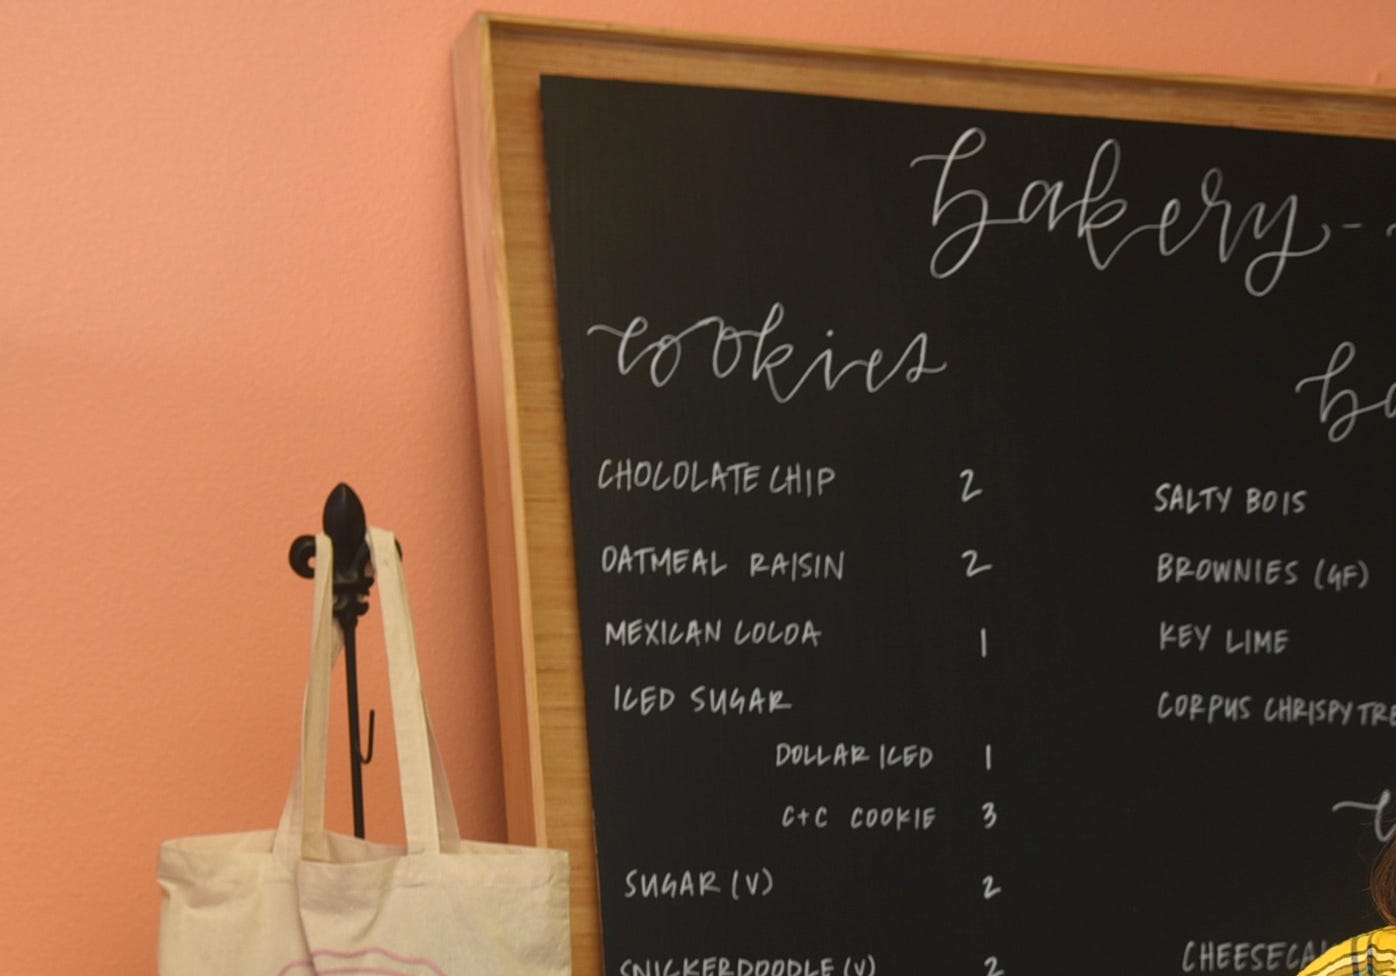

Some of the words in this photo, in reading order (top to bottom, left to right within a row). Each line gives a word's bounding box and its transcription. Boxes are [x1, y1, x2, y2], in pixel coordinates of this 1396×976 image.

[910, 124, 1332, 296] bakery
[587, 302, 946, 403] cookies
[598, 459, 760, 494] CHOCOLATE
[770, 463, 835, 497] CHIP
[960, 469, 982, 502] 2
[1155, 483, 1232, 514] SALTY
[1247, 488, 1306, 515] BOIS
[602, 545, 727, 576] OATMEAL
[750, 551, 844, 581] RAISIN
[962, 550, 992, 577] 2
[1157, 553, 1298, 584] BROWNIES
[1314, 559, 1369, 591] (GF)
[606, 619, 721, 645] MEXICAN
[1160, 622, 1211, 650] KEY
[1226, 630, 1288, 654] LIME
[615, 685, 675, 715] ICED
[691, 686, 791, 715] SUGAR
[1158, 691, 1251, 723] CORPUS
[1264, 696, 1353, 725] CHRISPY
[776, 743, 869, 766] DOLLAR
[880, 744, 933, 769] ICED
[782, 806, 827, 827] C+C
[851, 807, 935, 830] COOKIE
[982, 802, 997, 828] 3
[625, 869, 719, 897] SUGAR
[732, 868, 773, 900] (V)
[983, 876, 1001, 899] 2
